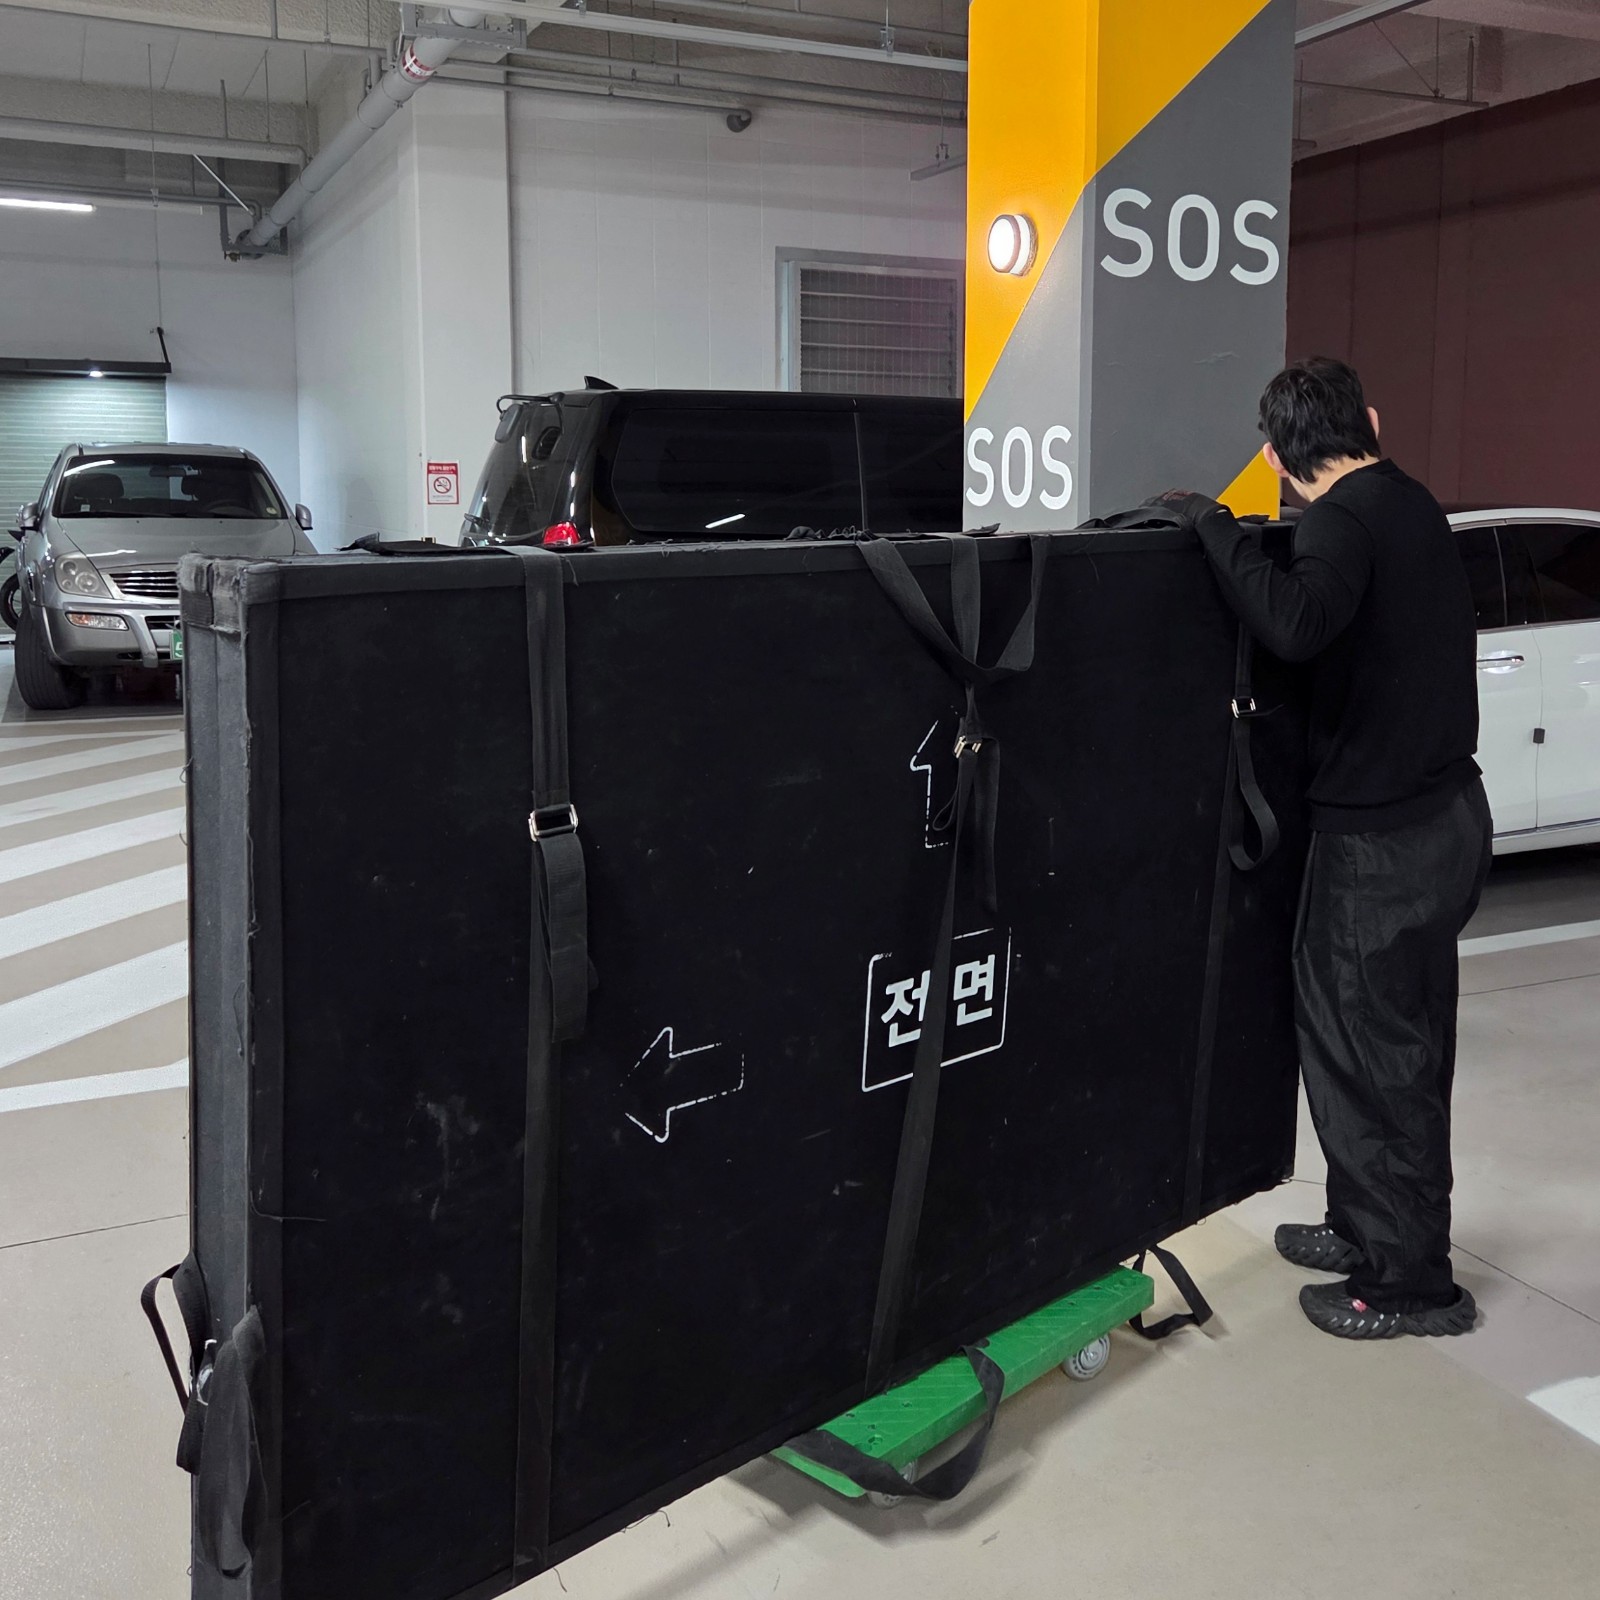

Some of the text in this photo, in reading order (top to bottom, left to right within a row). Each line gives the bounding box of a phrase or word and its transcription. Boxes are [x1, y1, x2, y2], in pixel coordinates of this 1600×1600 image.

[1100, 188, 1280, 285] SOS
[965, 425, 1073, 510] SOS
[881, 954, 995, 1048] 전면
